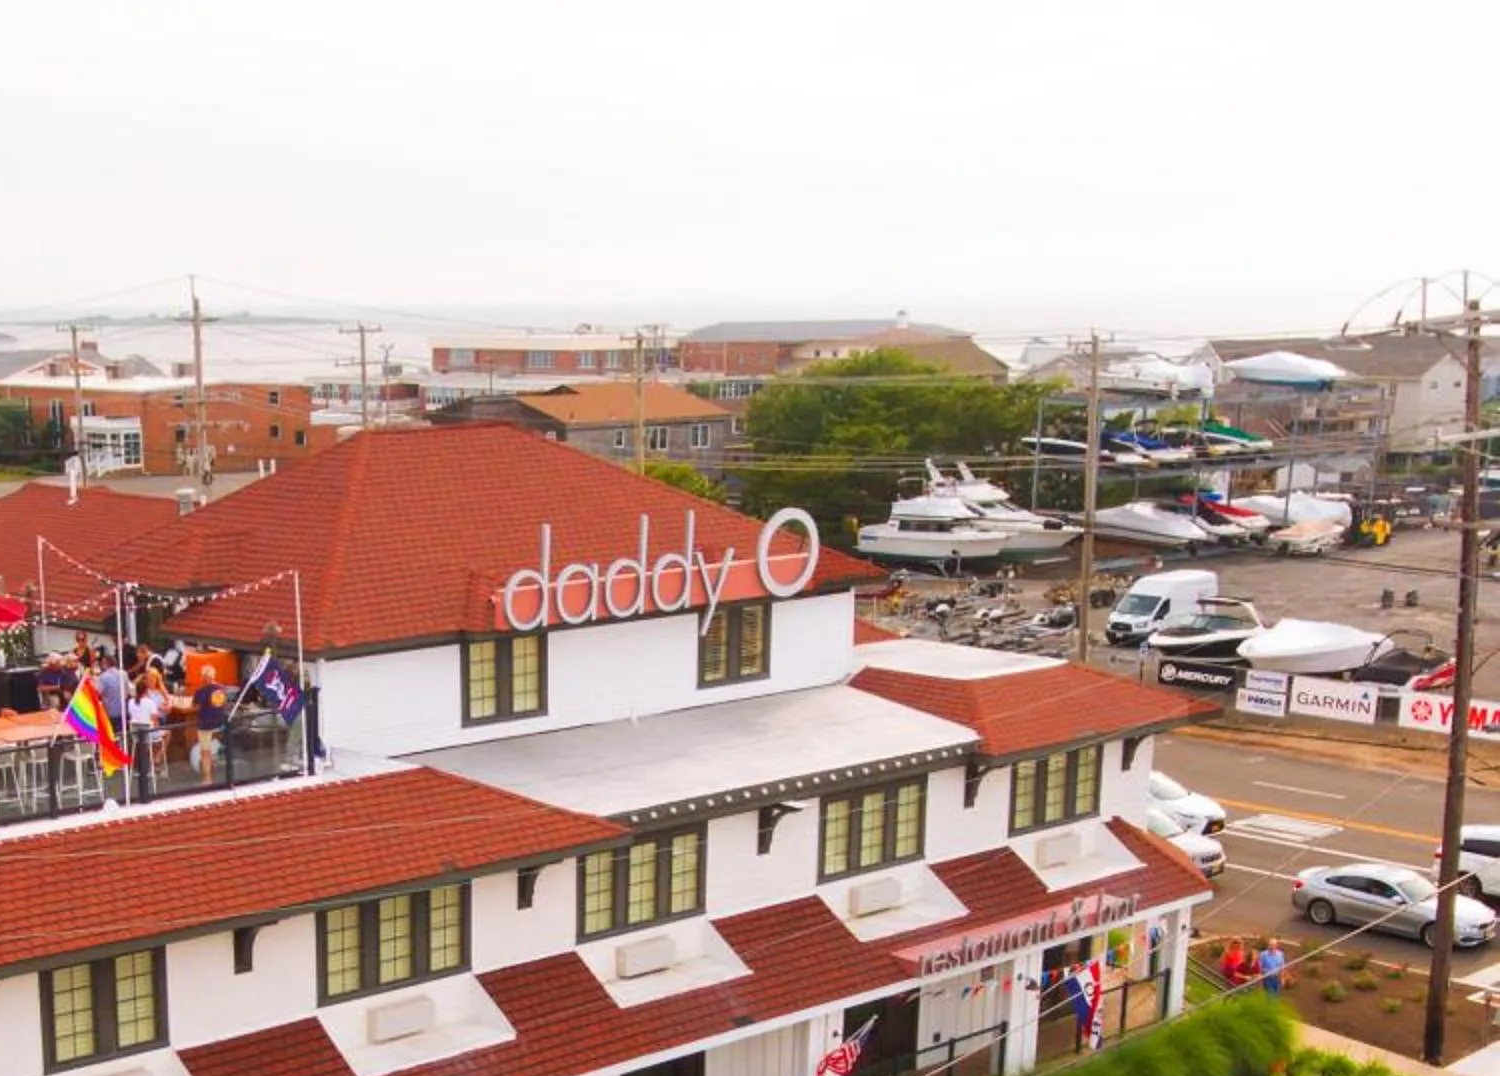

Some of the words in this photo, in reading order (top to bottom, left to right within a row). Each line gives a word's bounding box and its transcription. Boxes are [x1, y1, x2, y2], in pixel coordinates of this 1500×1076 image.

[504, 509, 735, 636] daddy
[757, 506, 820, 598] O
[1176, 668, 1233, 685] MERCURY
[1296, 691, 1372, 715] GARMIN
[1438, 701, 1500, 731] YMA
